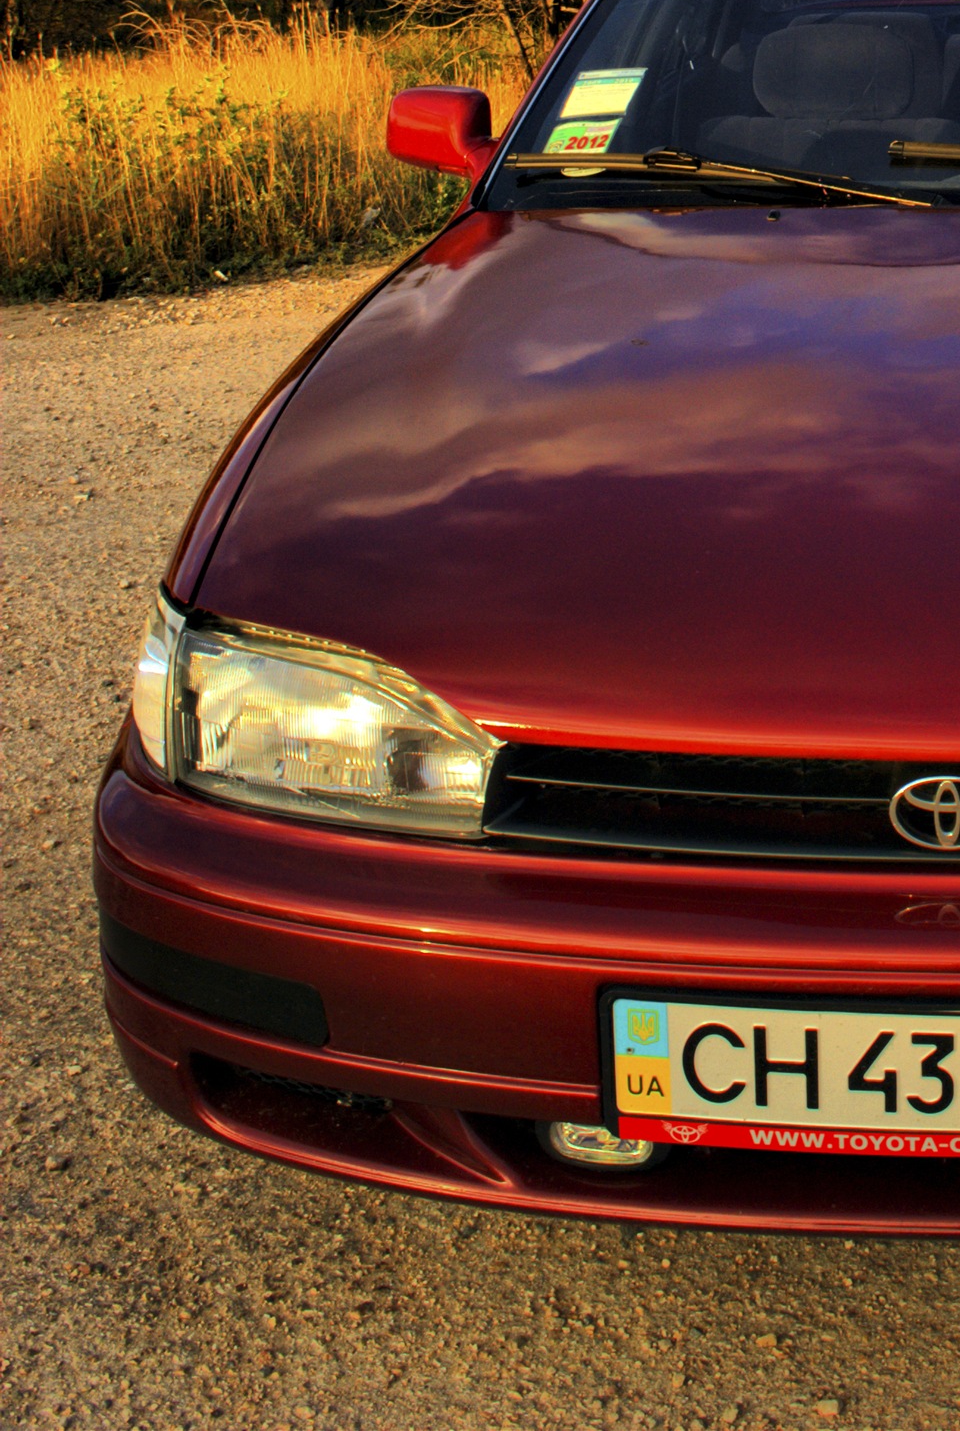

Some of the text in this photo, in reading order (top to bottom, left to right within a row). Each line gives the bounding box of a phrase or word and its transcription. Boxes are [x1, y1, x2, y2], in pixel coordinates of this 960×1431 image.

[564, 134, 609, 150] 2012
[682, 1023, 819, 1110] CH
[627, 1074, 665, 1098] UA
